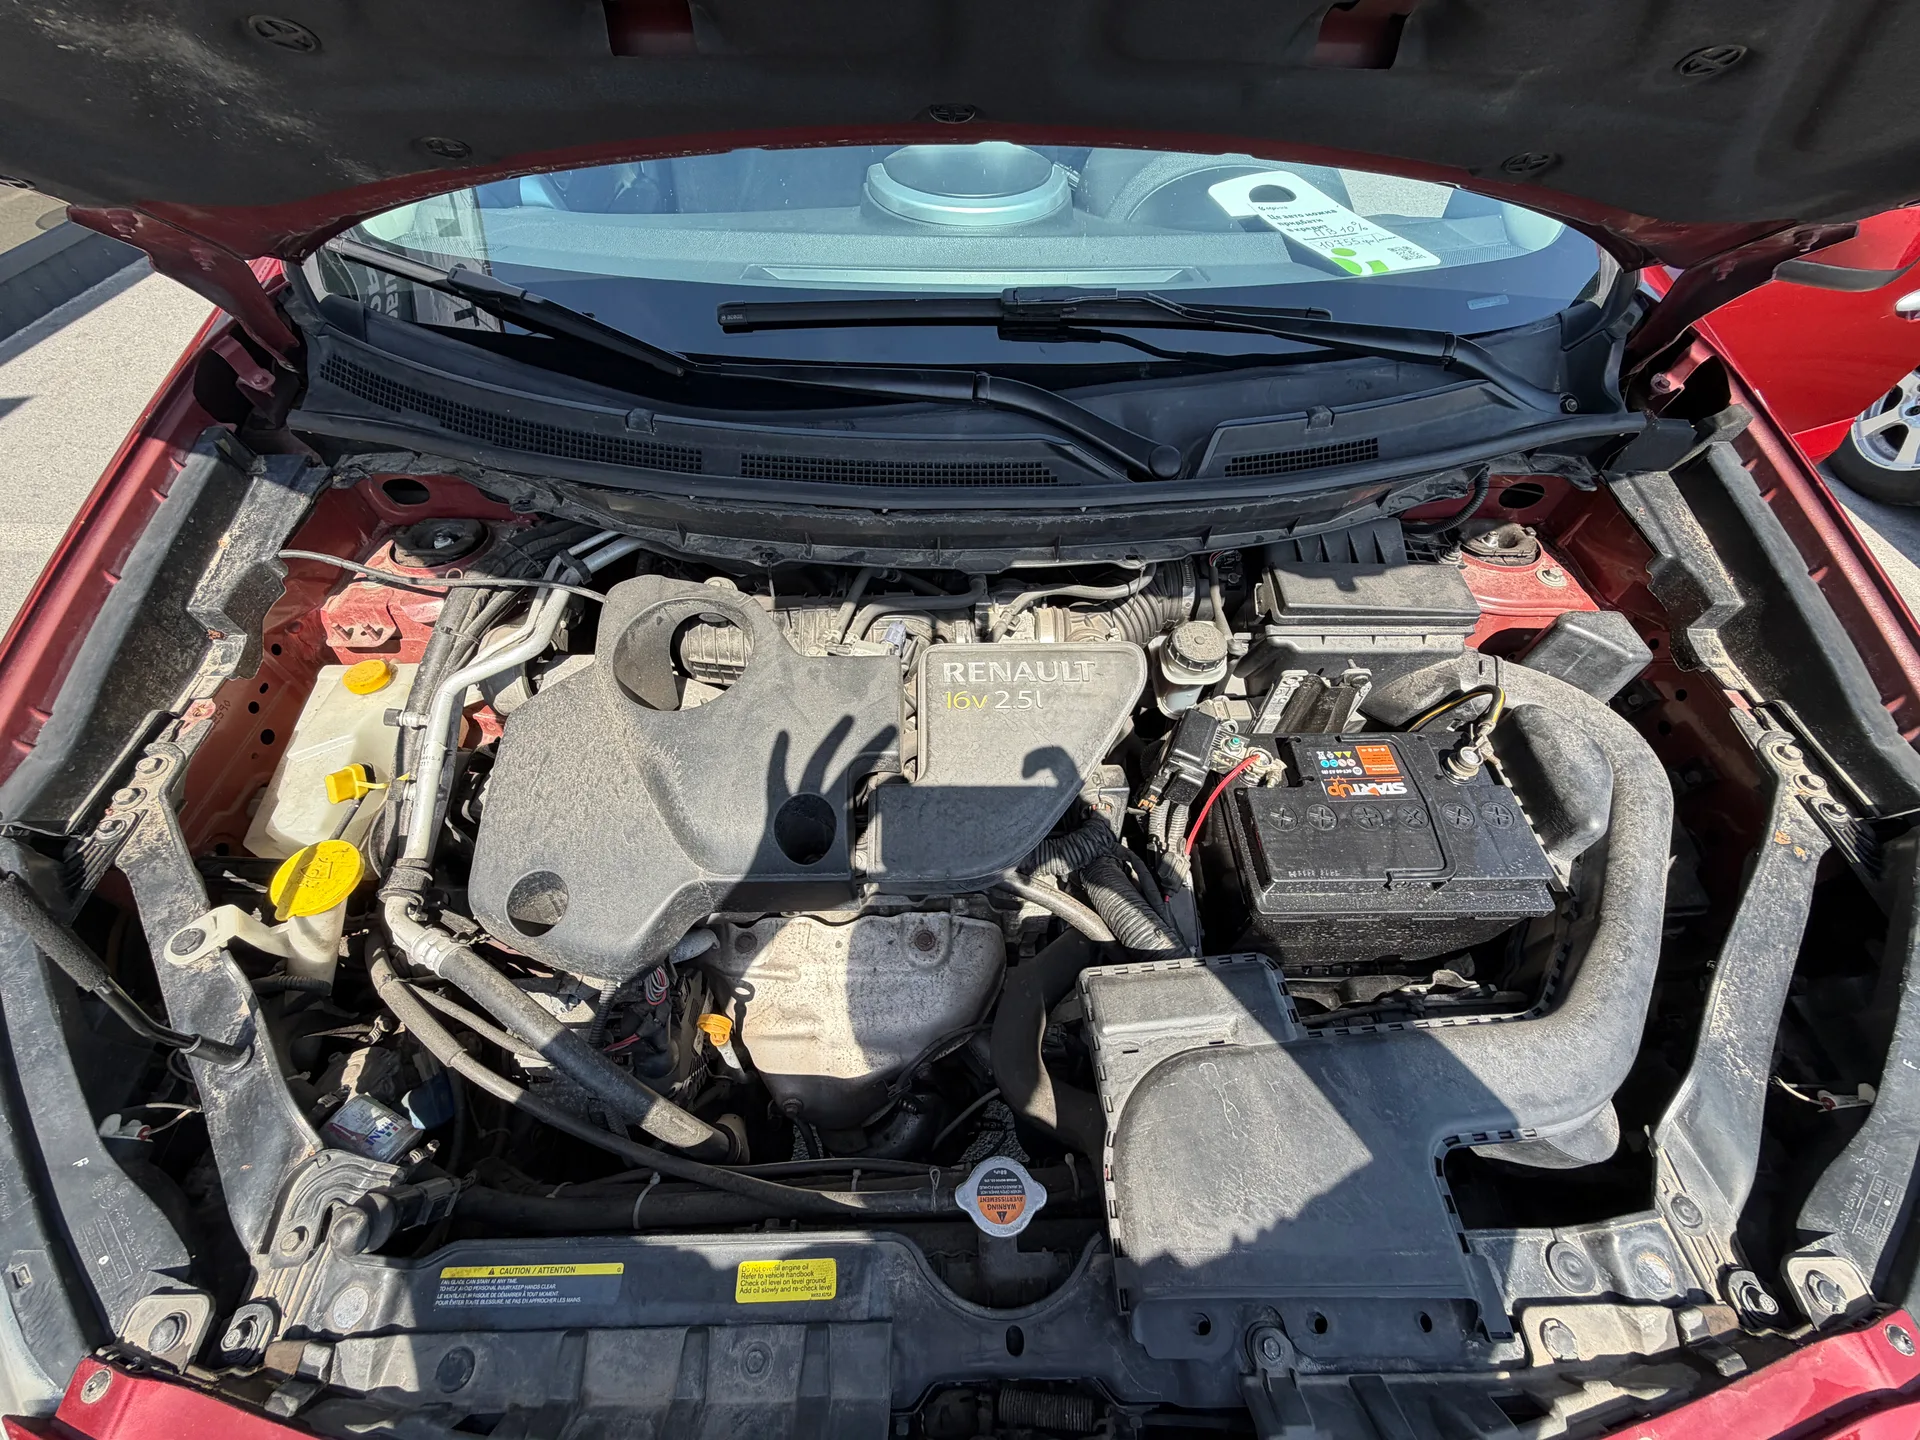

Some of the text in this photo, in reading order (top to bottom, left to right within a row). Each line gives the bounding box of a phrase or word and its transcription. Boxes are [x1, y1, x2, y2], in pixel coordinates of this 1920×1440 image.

[1277, 218, 1324, 226] придбати
[943, 660, 1095, 682] RENAULT
[945, 690, 988, 710] 16v
[1328, 782, 1408, 798] STARTUP
[499, 1267, 530, 1275] CAUTION
[537, 1266, 576, 1274] ATTENTION
[806, 1276, 826, 1286] ground
[761, 1286, 779, 1294] slowly
